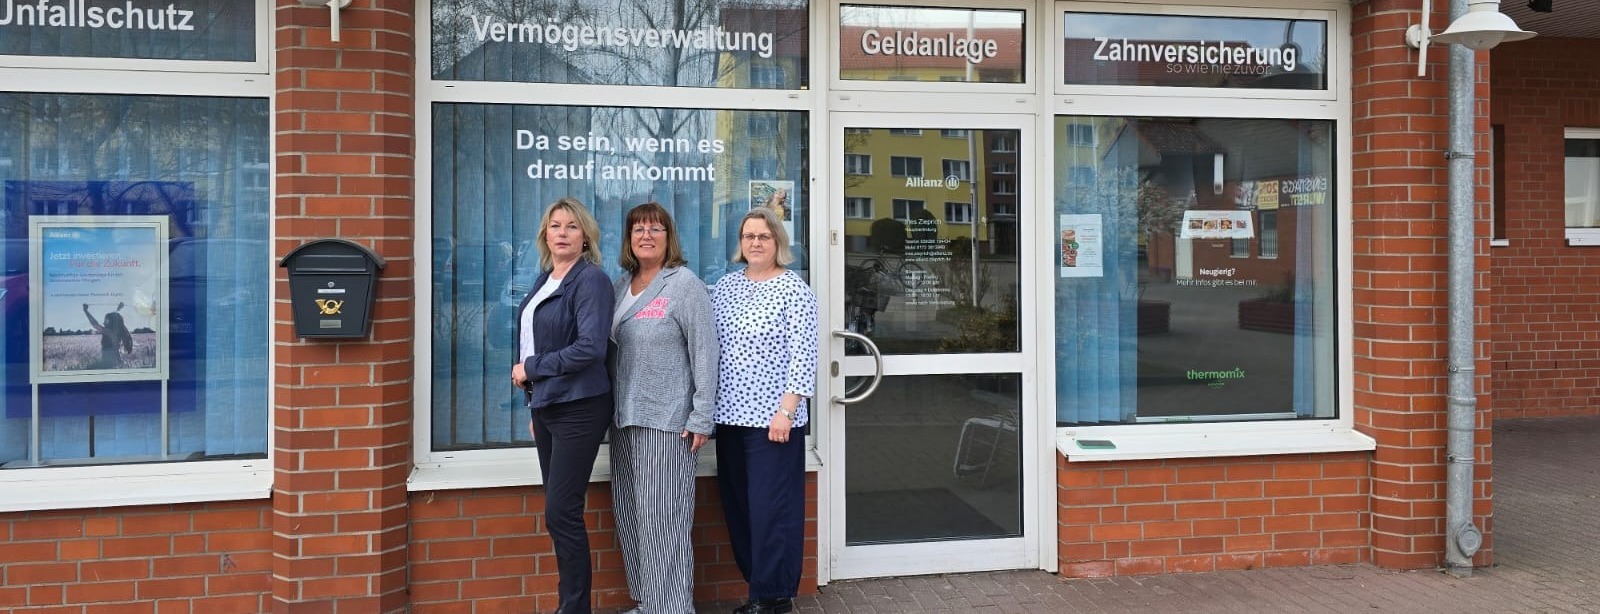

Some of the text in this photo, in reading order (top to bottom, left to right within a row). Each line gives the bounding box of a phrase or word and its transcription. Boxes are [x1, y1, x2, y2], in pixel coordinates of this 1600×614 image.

[470, 14, 774, 59] Vermögensverwaltung
[861, 29, 998, 64] Geldanlage
[1093, 36, 1296, 72] Zahnversicherung
[1166, 64, 1182, 74] so
[1185, 64, 1209, 74] wie
[1210, 64, 1232, 74] nie
[516, 129, 725, 156] Da sein, wenn es
[527, 159, 716, 181] drauf ankommt
[905, 176, 943, 188] Allianz
[49, 251, 71, 260] Jetzt
[1199, 267, 1236, 278] Neugierig?
[1176, 279, 1194, 287] Mehr
[1195, 279, 1211, 287] Infos
[1187, 367, 1246, 380] thermomix
